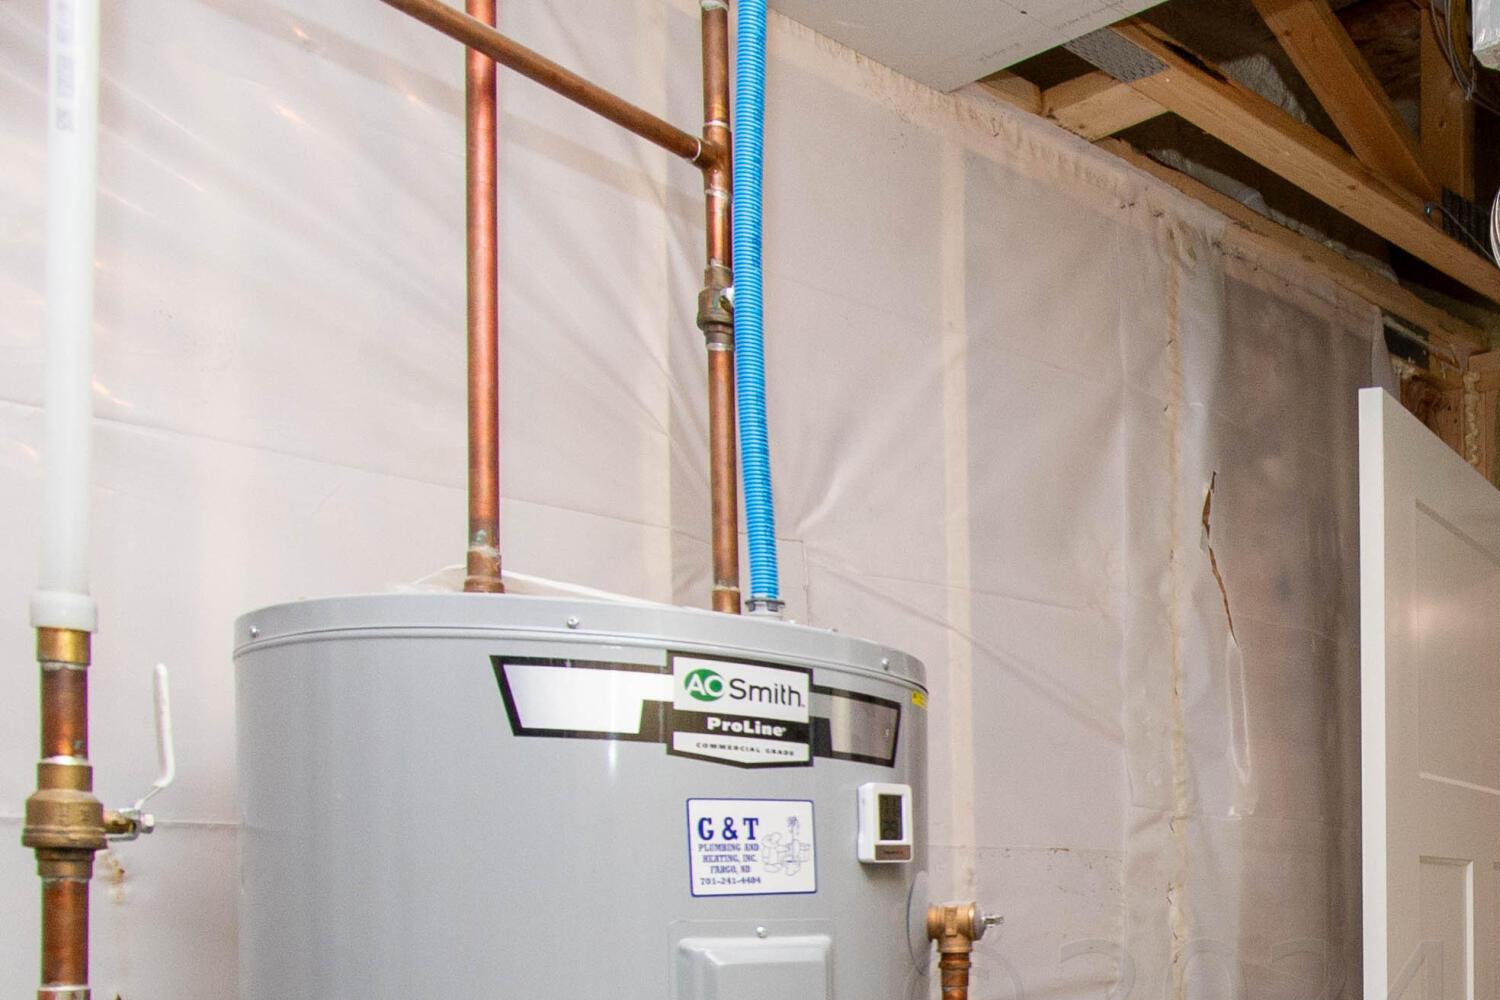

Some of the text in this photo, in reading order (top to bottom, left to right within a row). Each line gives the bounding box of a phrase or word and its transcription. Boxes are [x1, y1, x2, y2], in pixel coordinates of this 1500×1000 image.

[729, 678, 802, 708] Smith
[706, 716, 784, 737] ProLine
[696, 742, 795, 756] COMMERCIAL GRADE
[697, 816, 759, 841] G & T
[698, 843, 759, 852] PLUMBING AND
